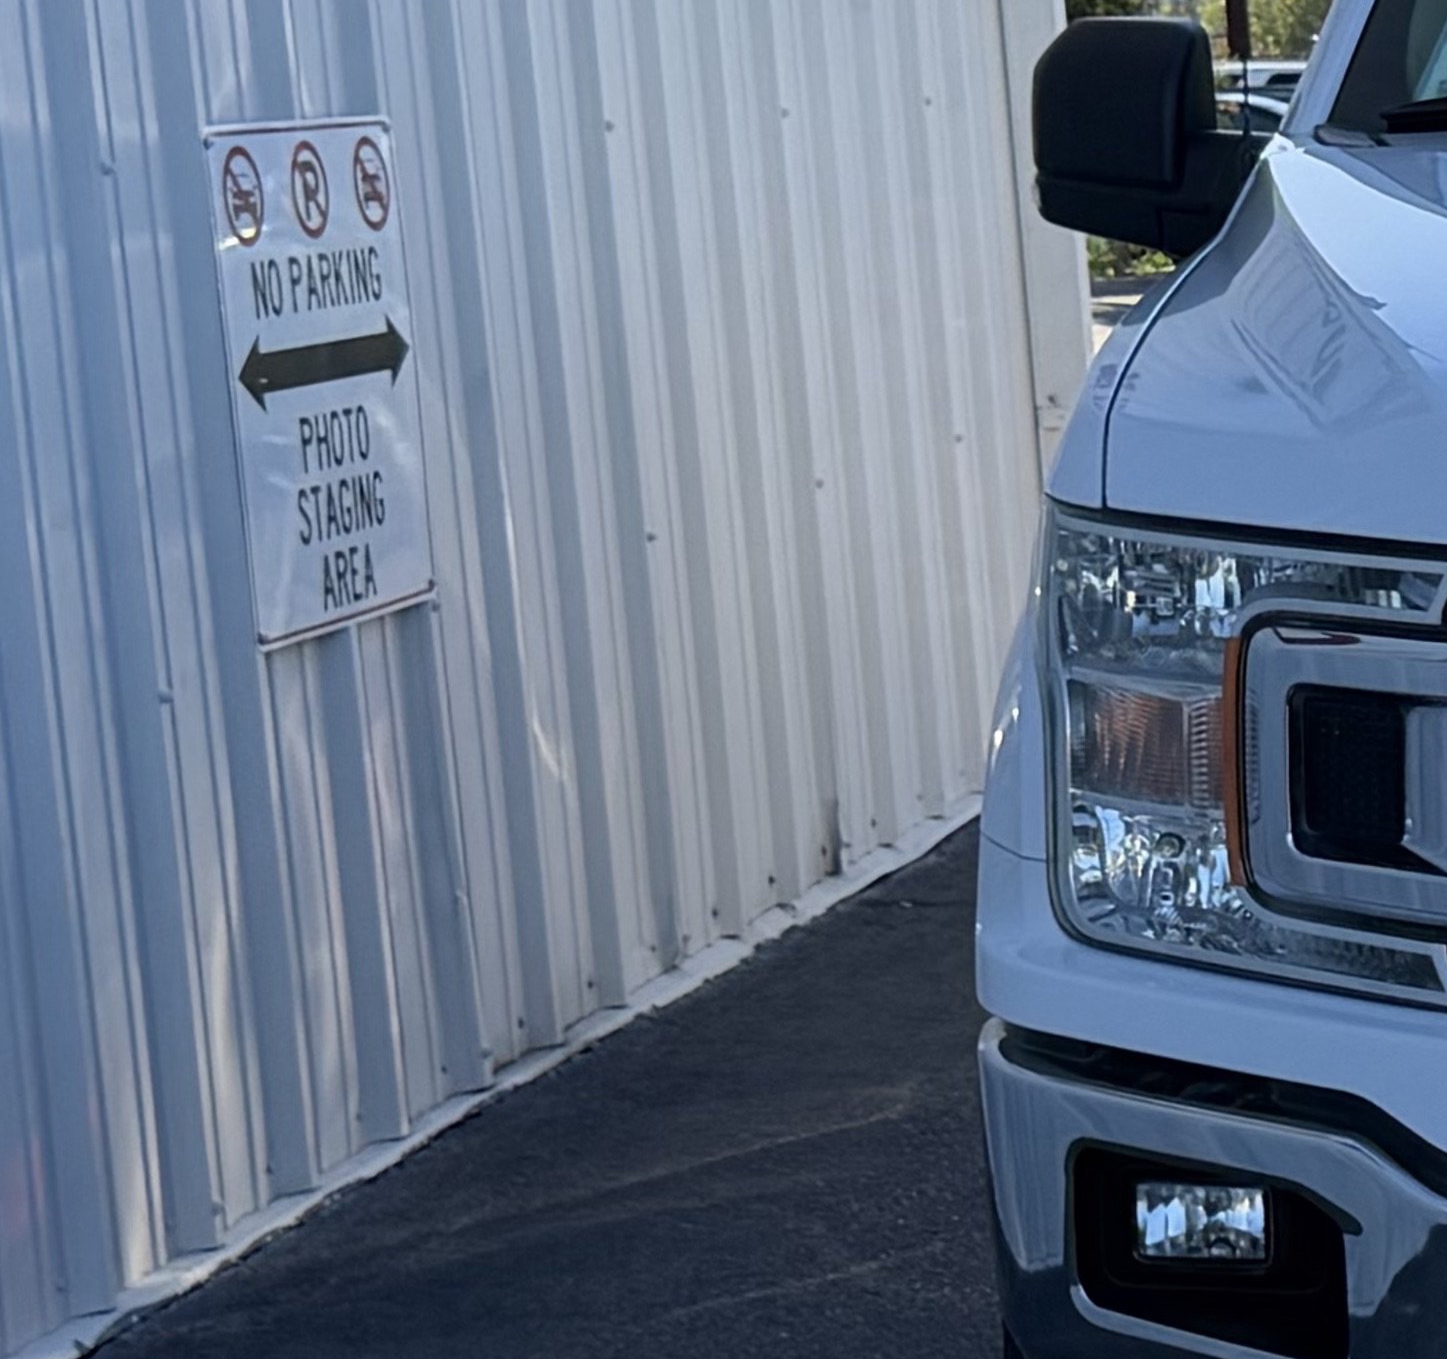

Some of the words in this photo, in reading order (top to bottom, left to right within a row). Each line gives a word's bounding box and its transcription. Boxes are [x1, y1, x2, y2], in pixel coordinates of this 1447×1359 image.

[251, 258, 284, 320] NO
[288, 245, 382, 313] PARKING
[299, 405, 370, 474] PHOTO
[297, 470, 385, 546] STAGING
[324, 543, 377, 612] AREA
